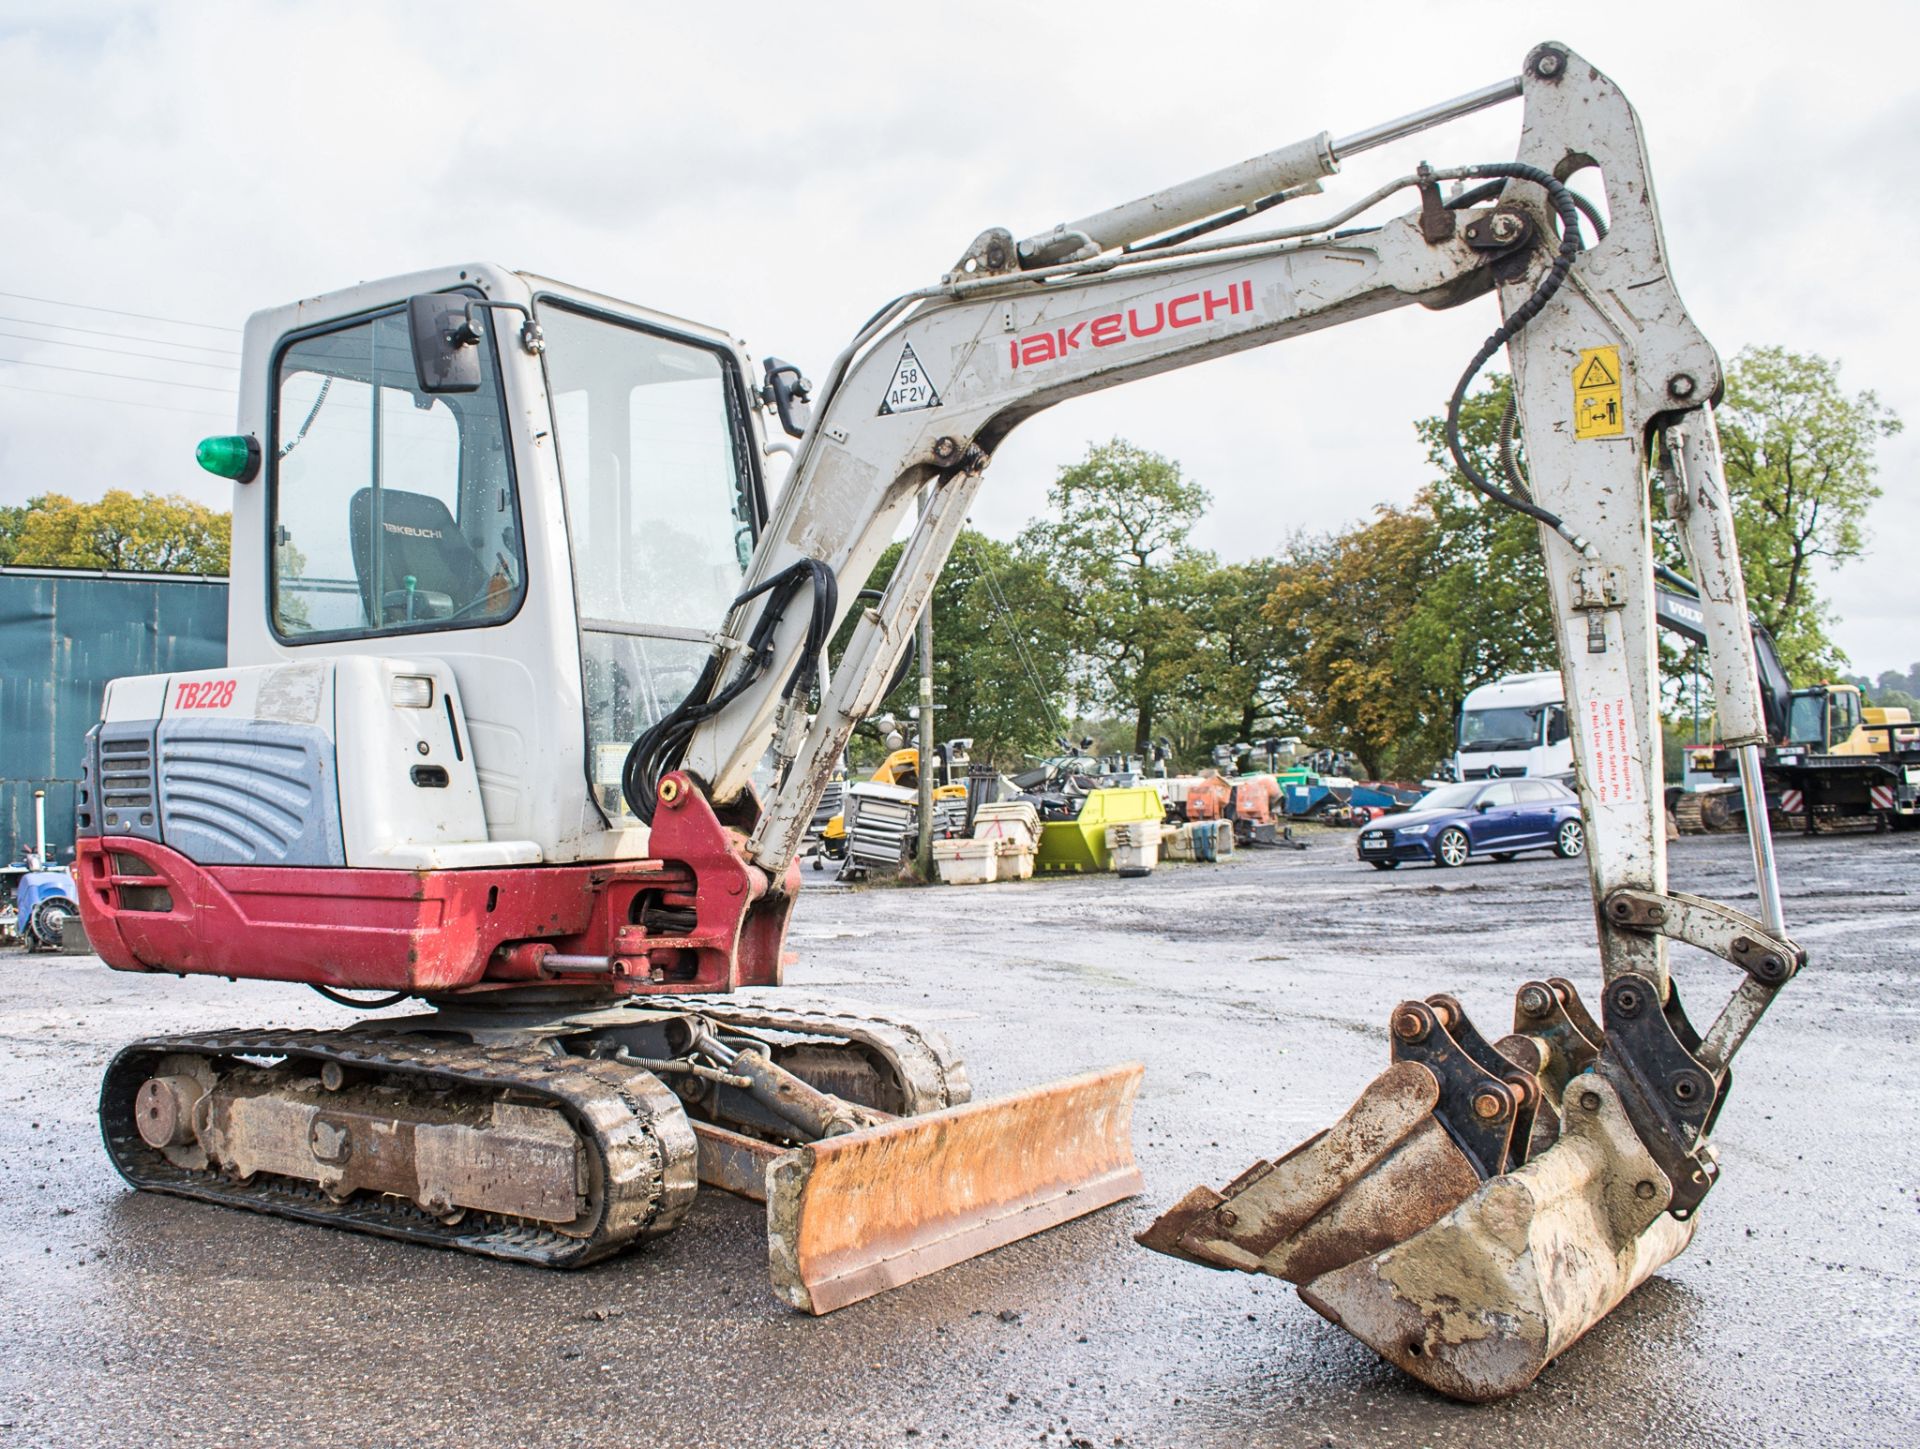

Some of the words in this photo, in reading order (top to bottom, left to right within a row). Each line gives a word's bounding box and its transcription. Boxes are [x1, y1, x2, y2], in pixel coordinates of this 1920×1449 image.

[900, 368, 917, 385] 58
[892, 385, 926, 405] AF2Y
[1667, 600, 1704, 624] VOLV
[174, 680, 237, 710] TB228
[1606, 730, 1614, 752] Hitch
[1619, 719, 1627, 752] Machine
[1596, 751, 1605, 783] Without
[1609, 755, 1617, 781] Safety
[1622, 755, 1630, 792] Requires
